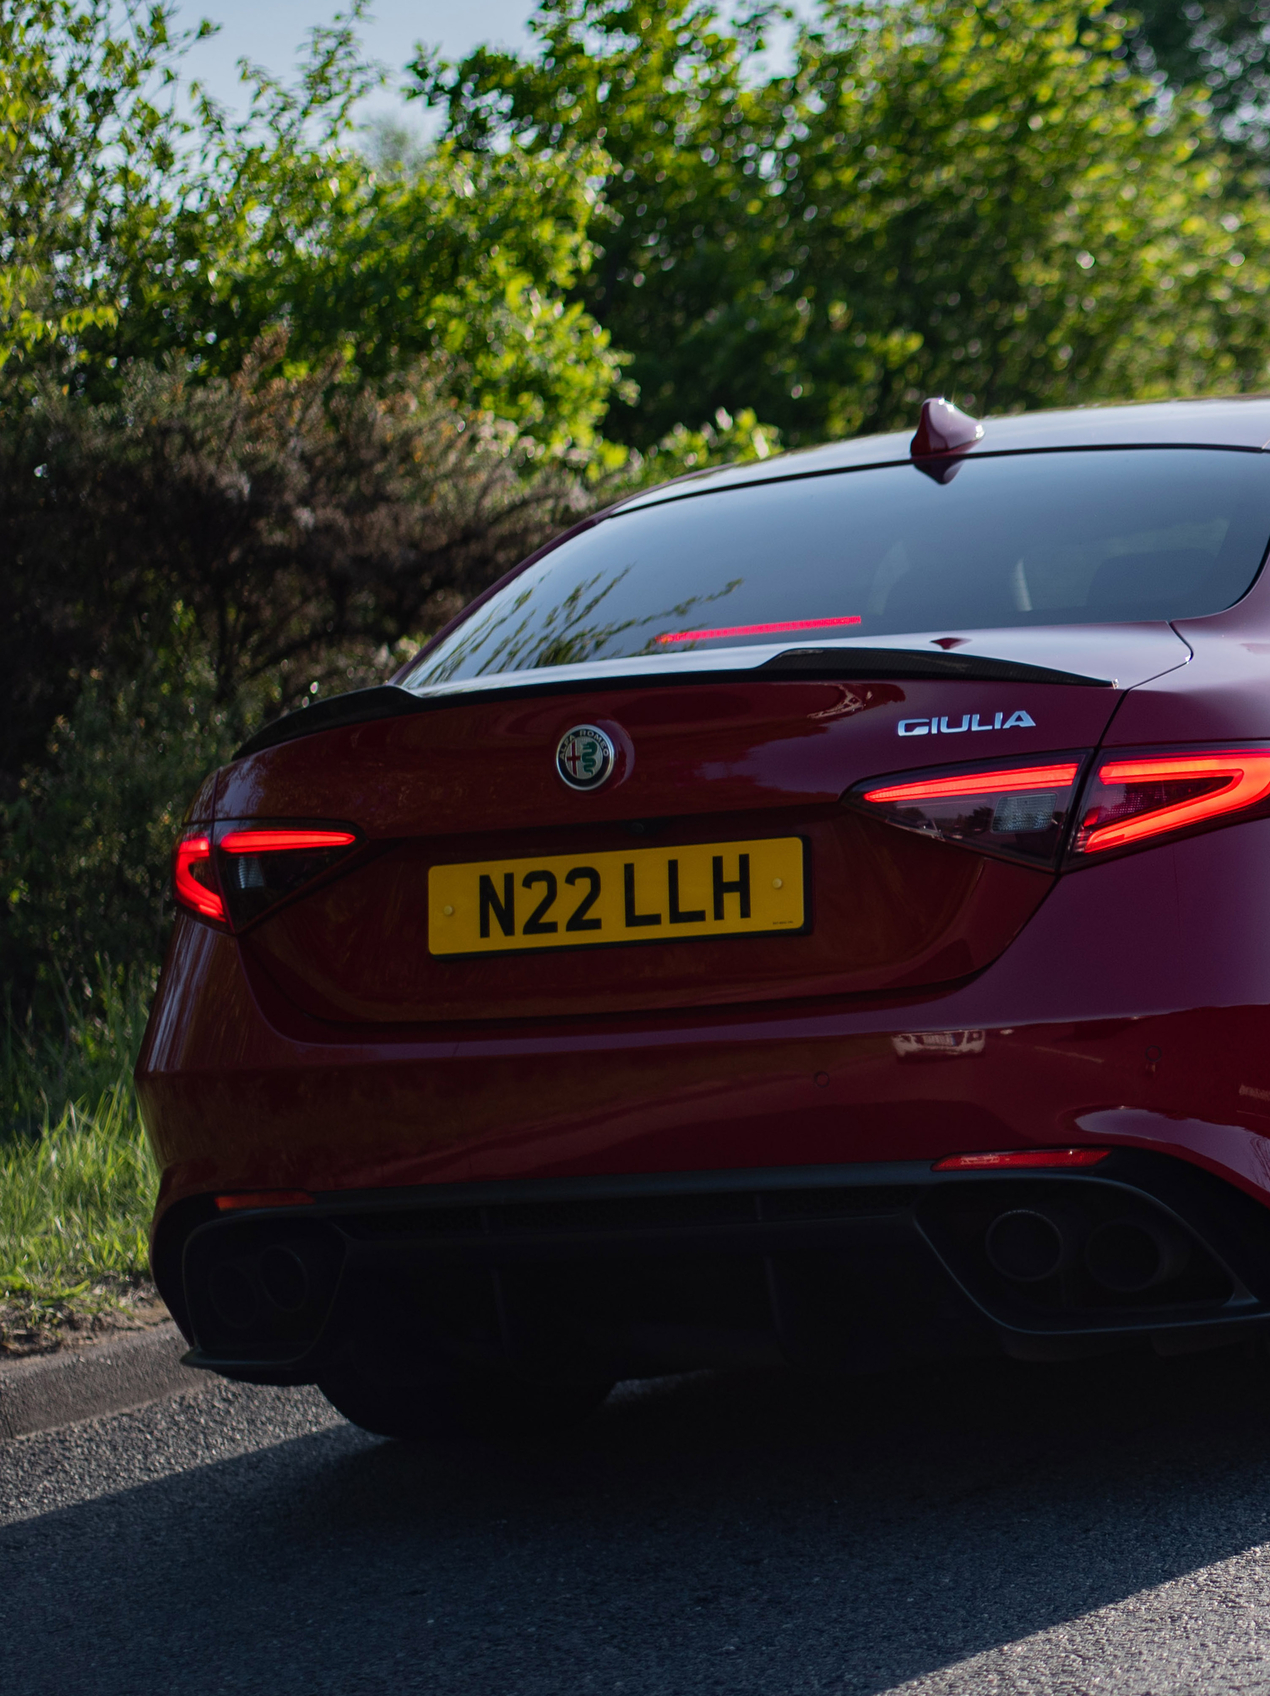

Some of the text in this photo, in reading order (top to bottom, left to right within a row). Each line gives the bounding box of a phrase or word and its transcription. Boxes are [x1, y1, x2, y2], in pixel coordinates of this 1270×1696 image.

[897, 710, 1036, 737] GIULIA
[560, 729, 609, 760] ALFA ROMEO
[479, 853, 751, 939] N22 LLH
